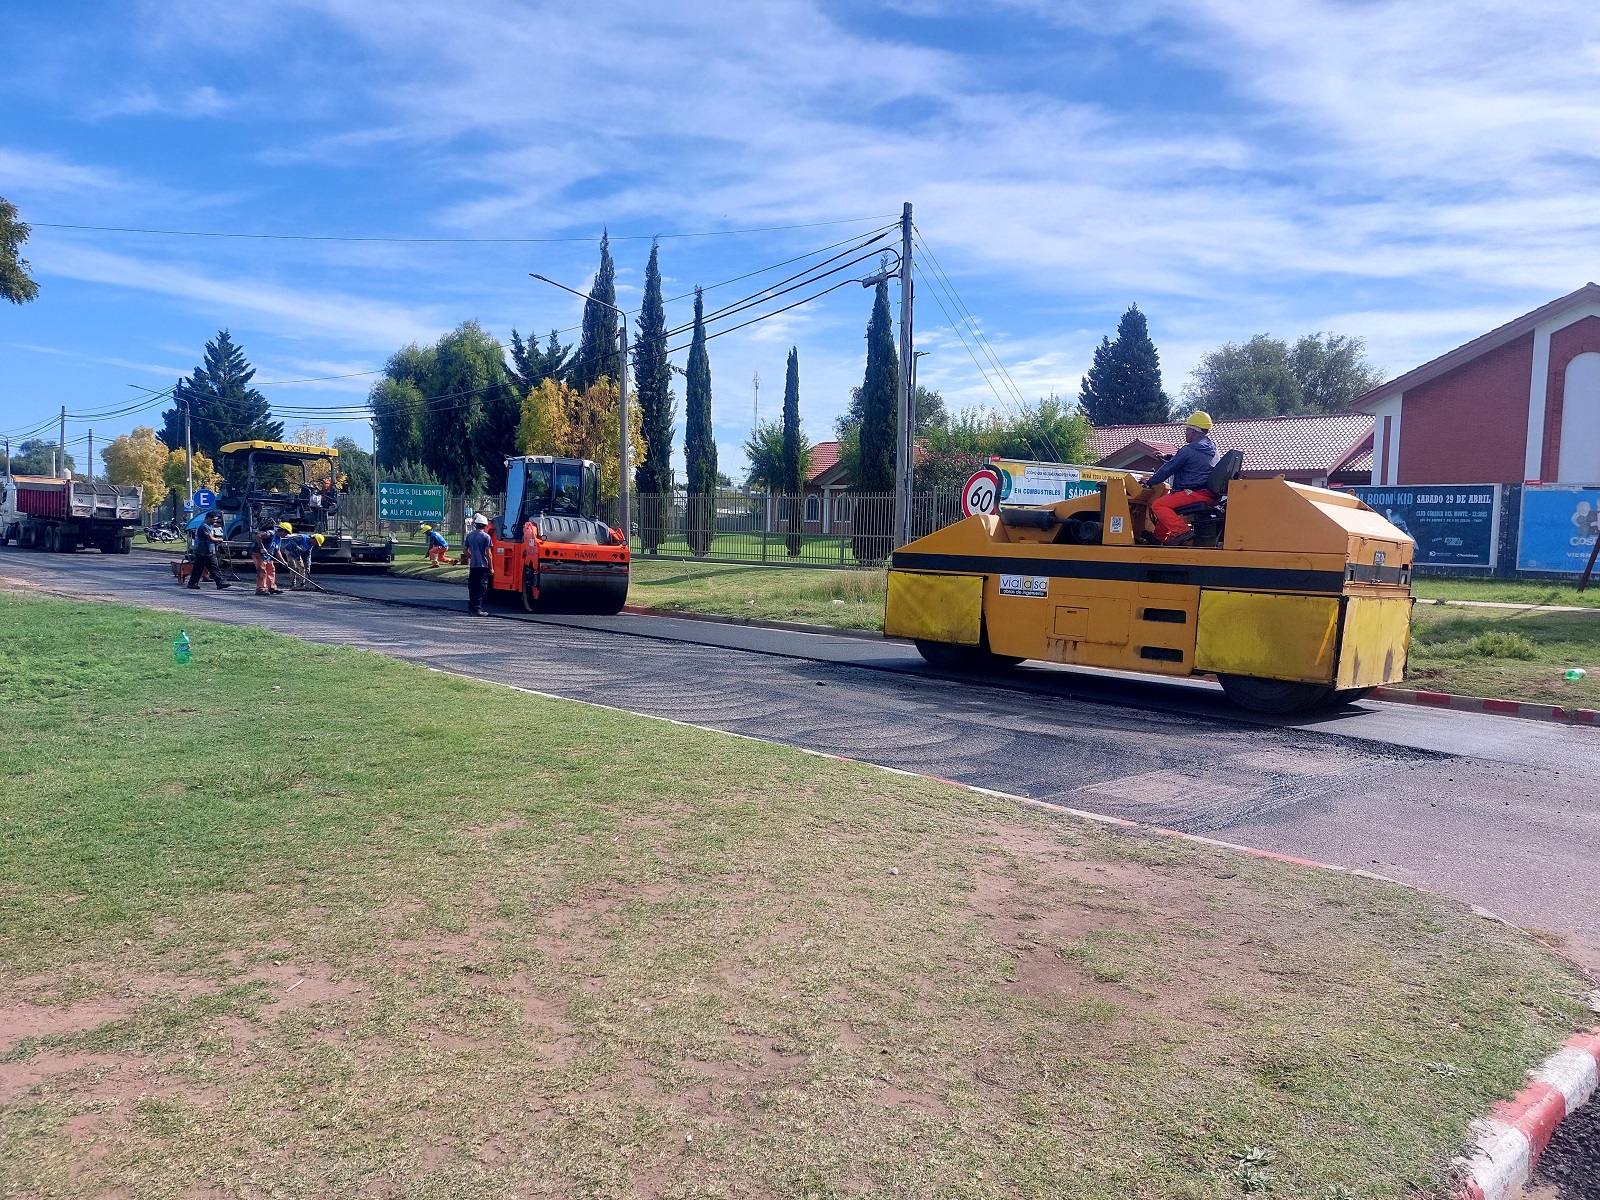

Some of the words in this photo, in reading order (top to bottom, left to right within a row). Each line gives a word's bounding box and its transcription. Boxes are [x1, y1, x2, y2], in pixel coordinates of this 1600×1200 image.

[200, 493, 210, 505] E
[971, 486, 992, 512] 60
[1367, 493, 1393, 504] BOOM
[1397, 493, 1413, 504] KID
[1416, 495, 1443, 504] SABADO
[1446, 495, 1453, 504] 29
[1456, 495, 1466, 504] DE
[1468, 495, 1491, 504] ABRIL
[1570, 537, 1598, 546] COST
